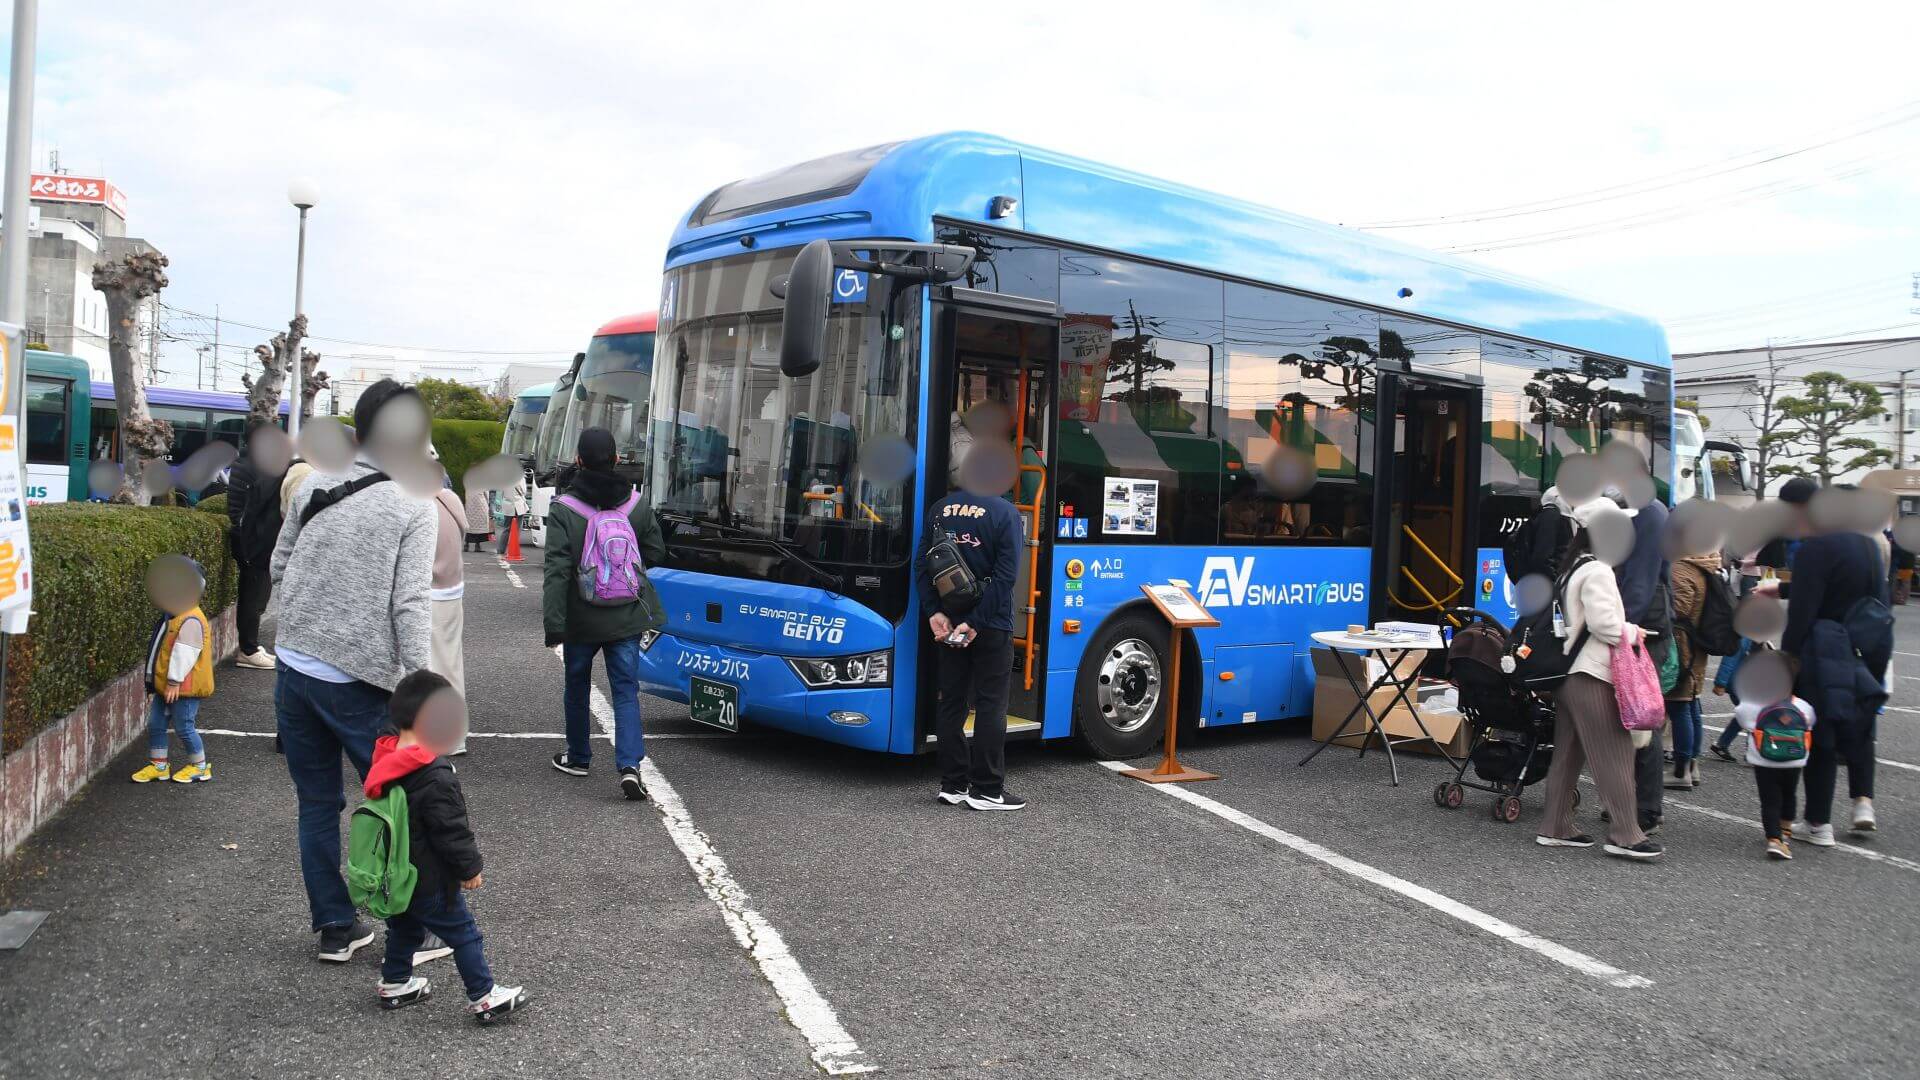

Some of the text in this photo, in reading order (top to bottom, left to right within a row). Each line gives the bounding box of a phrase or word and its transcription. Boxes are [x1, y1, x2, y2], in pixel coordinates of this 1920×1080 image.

[31, 177, 100, 197] やまひろ
[943, 504, 986, 519] STAFF
[1103, 558, 1122, 570] 入口
[1197, 556, 1256, 608] EV
[1247, 583, 1317, 606] SMART
[1064, 594, 1084, 608] 乗合
[740, 604, 847, 629] EV SMART BUS
[783, 621, 844, 645] GEIYO
[677, 650, 750, 681] ノンステップバス
